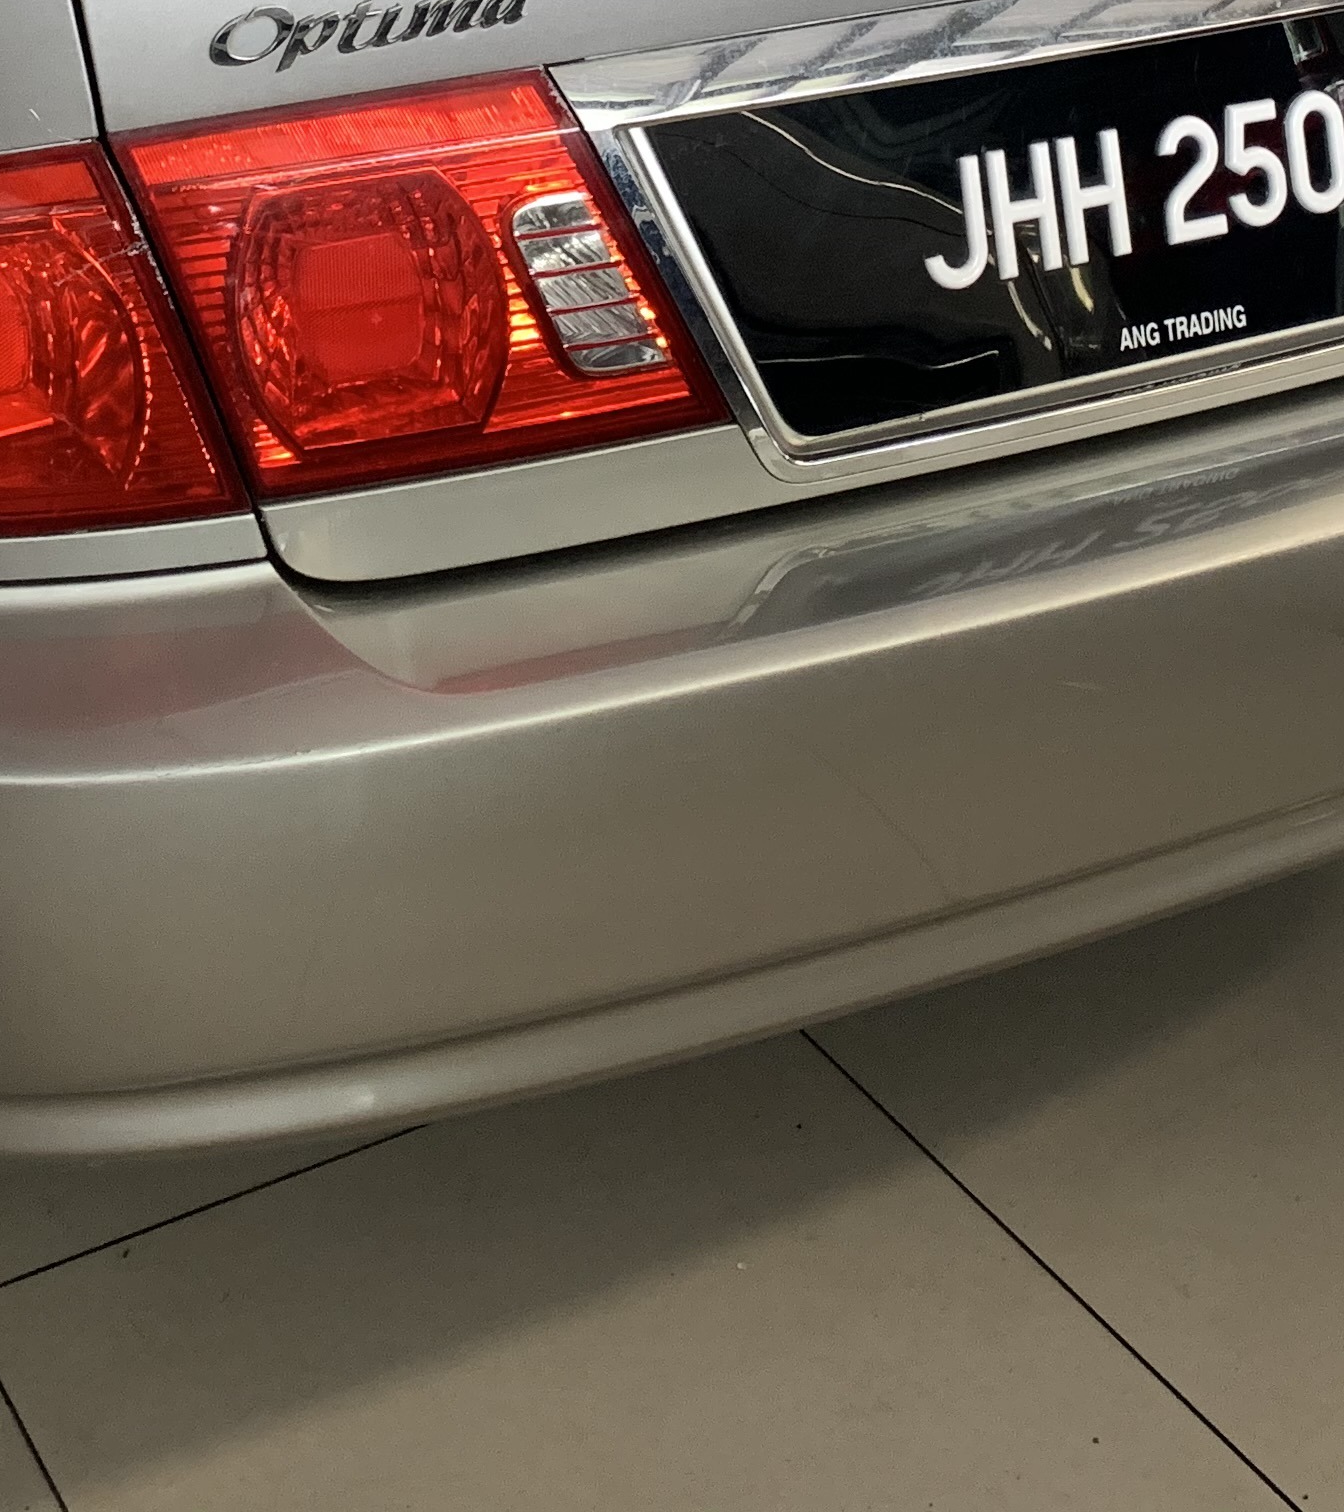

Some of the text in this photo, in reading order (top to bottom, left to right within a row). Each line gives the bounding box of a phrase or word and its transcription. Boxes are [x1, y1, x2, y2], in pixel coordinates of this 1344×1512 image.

[925, 128, 1133, 290] JHH
[1119, 304, 1248, 352] ANG TRADING
